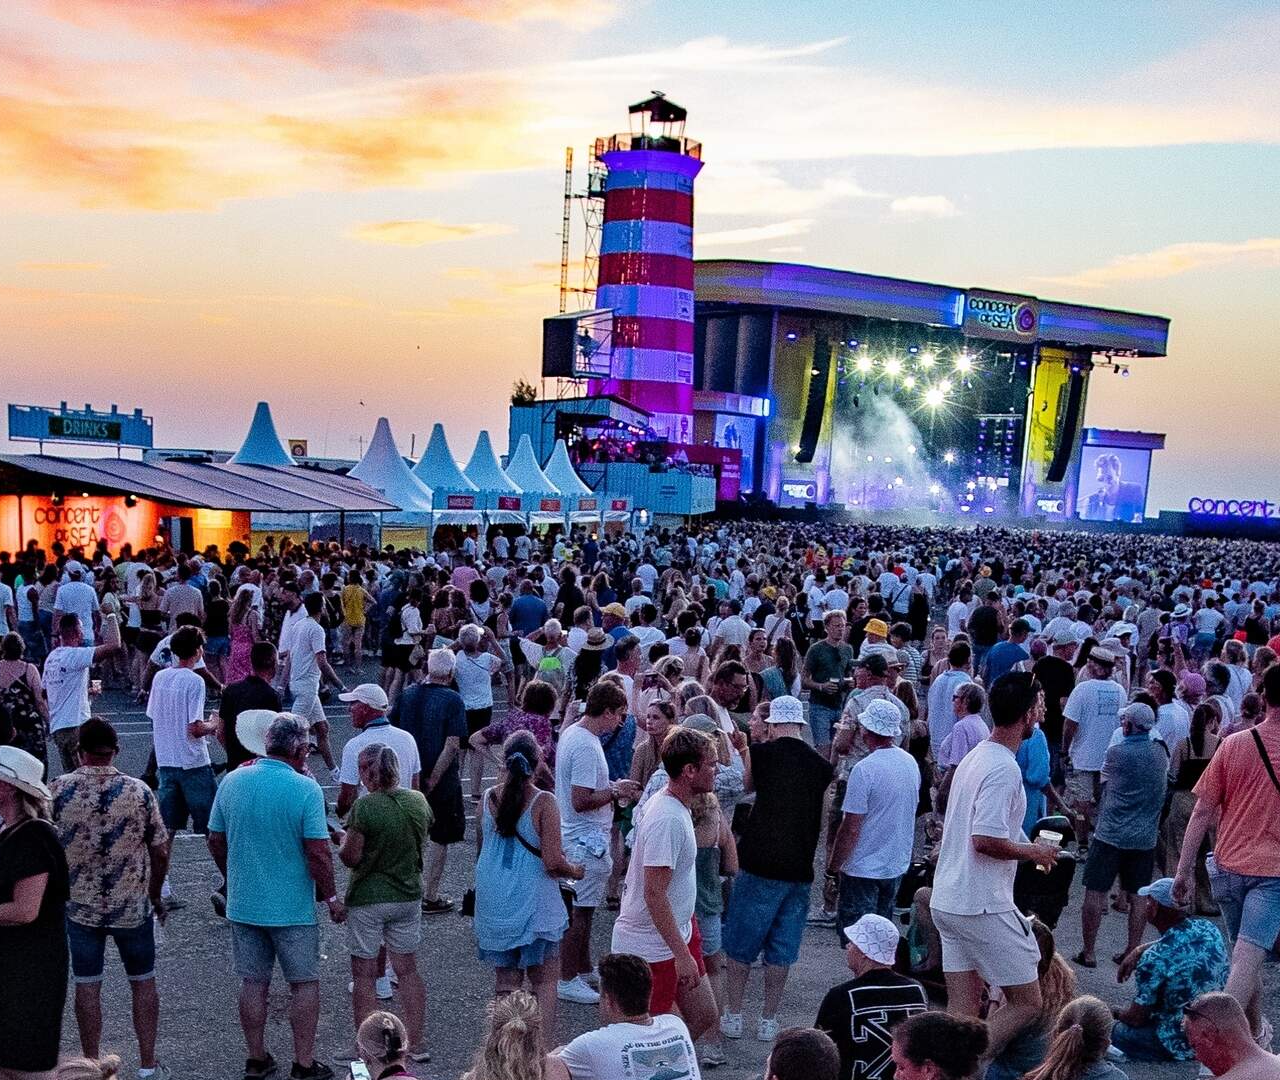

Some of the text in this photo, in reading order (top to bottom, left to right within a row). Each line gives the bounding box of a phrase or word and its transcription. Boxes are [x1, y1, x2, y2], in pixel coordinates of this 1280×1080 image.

[992, 313, 1015, 330] SEA
[63, 418, 109, 438] DRINKS
[34, 505, 100, 526] concert
[1188, 497, 1274, 519] concert
[55, 525, 99, 547] at SEA
